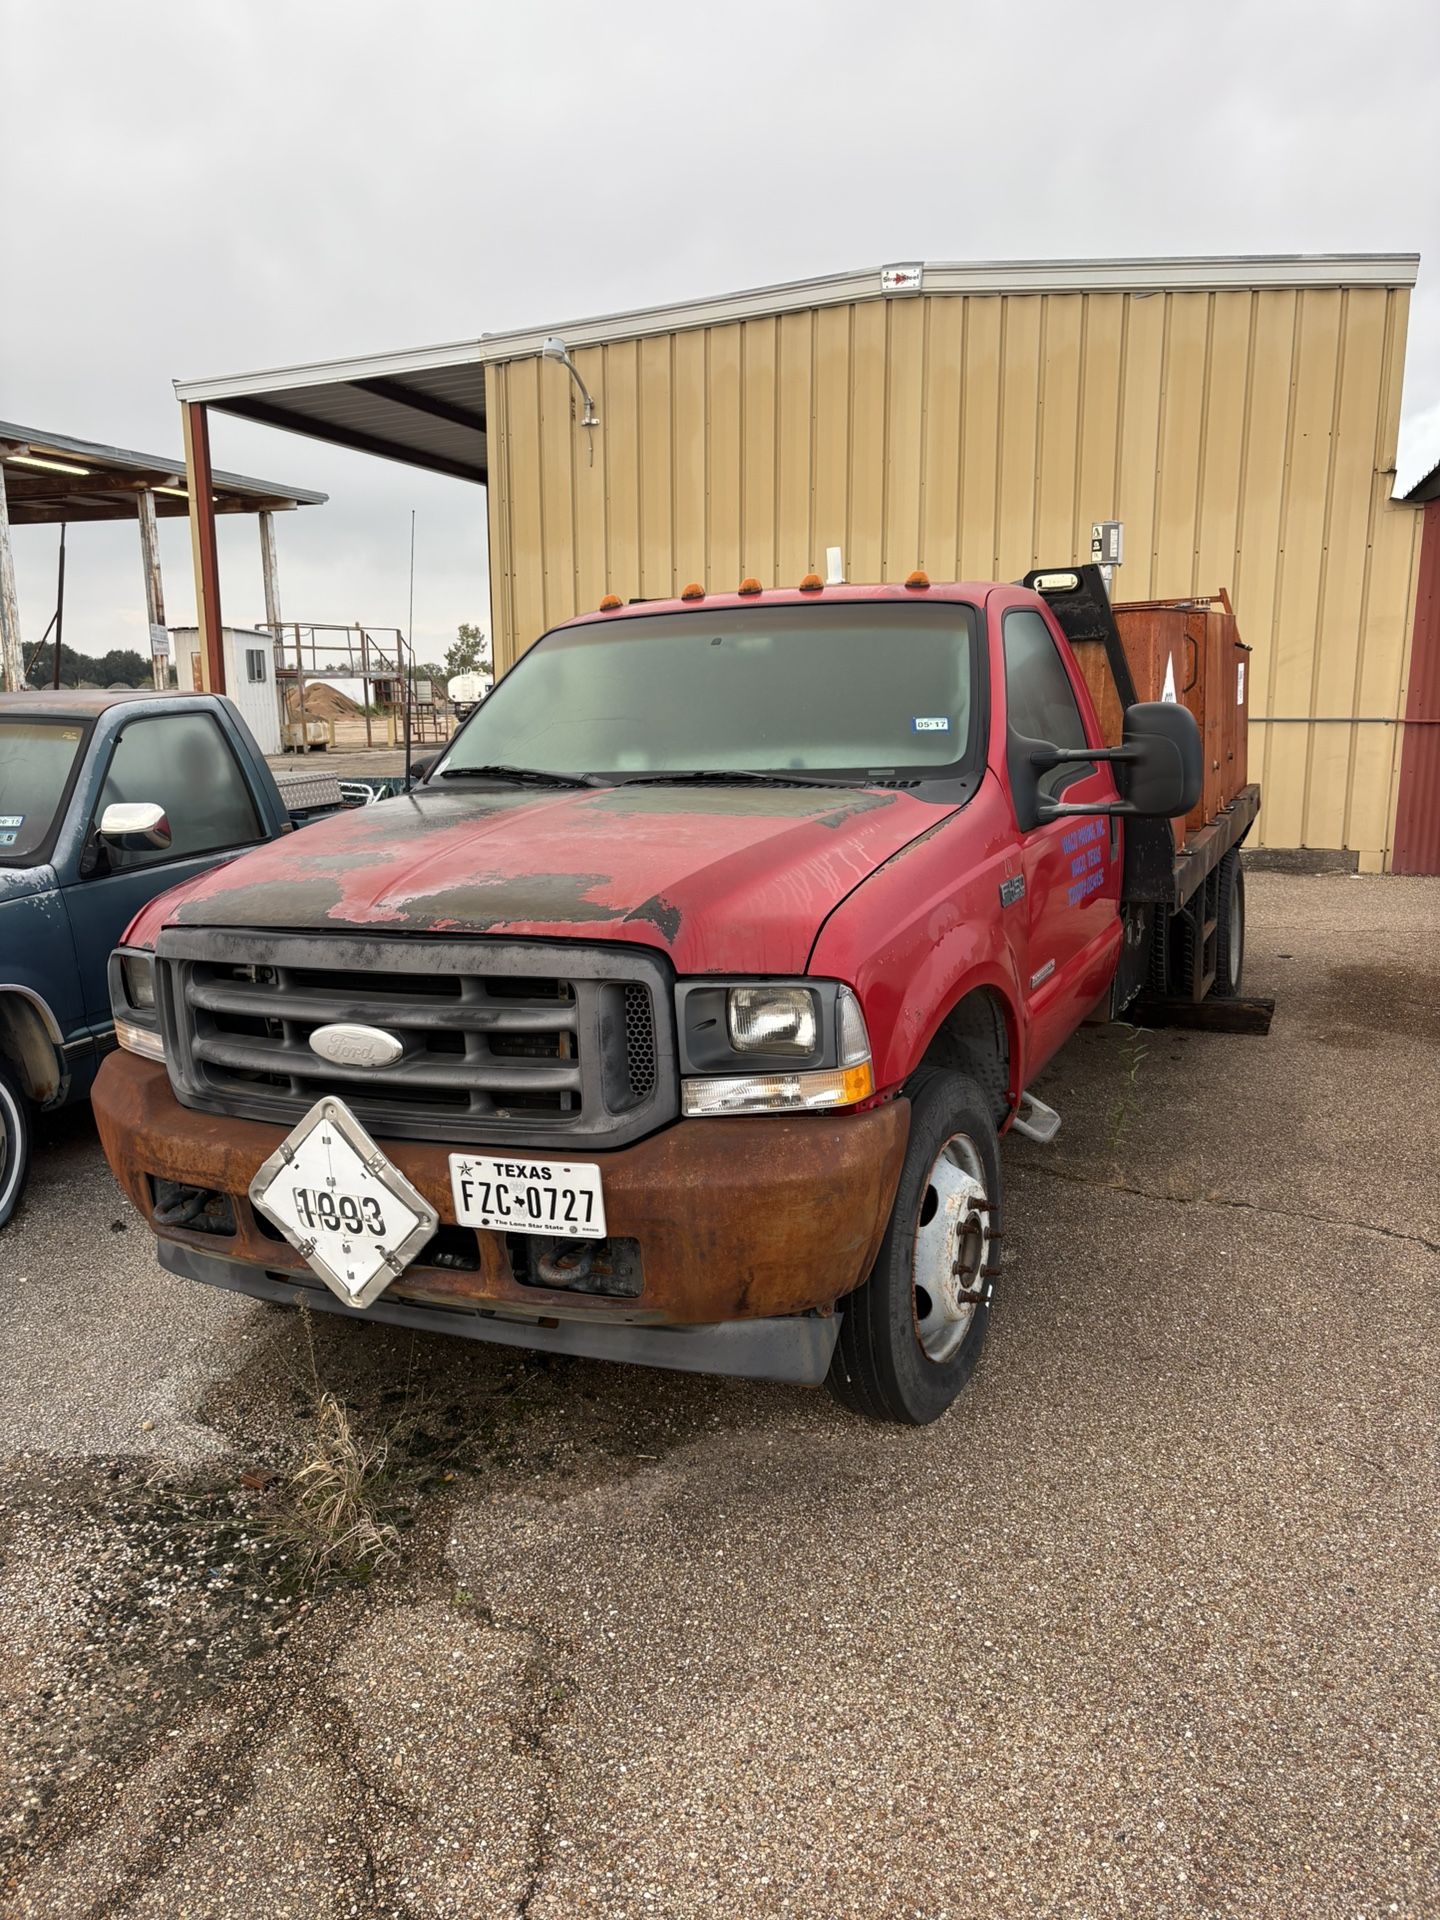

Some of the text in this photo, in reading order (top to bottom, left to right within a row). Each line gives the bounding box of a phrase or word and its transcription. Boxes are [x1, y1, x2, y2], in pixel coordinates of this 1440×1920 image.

[326, 1033, 376, 1060] Ford
[493, 1162, 553, 1181] TEXAS
[297, 1188, 387, 1237] 1993
[494, 1219, 509, 1227] The
[509, 1220, 527, 1228] Lone
[528, 1222, 543, 1230] Star
